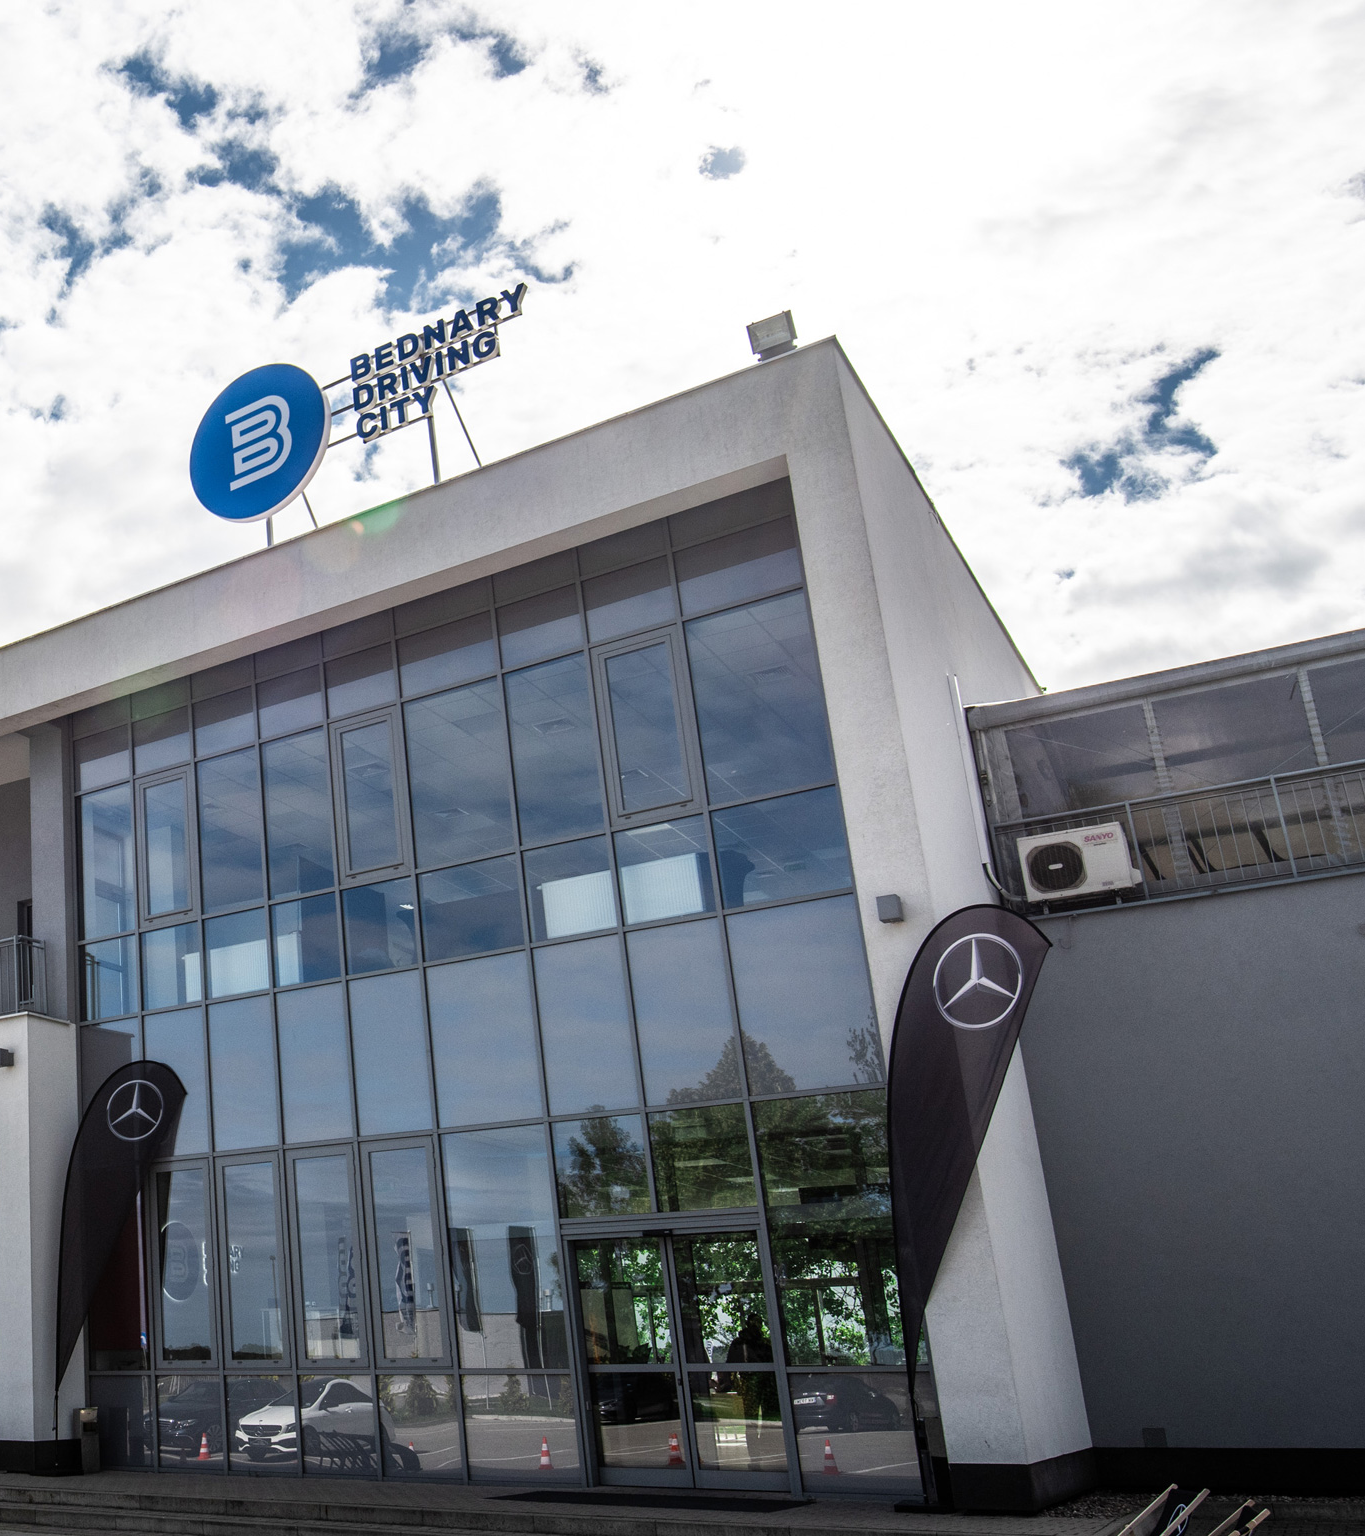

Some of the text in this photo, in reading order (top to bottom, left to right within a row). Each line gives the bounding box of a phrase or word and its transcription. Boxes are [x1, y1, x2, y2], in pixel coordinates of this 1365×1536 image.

[350, 282, 527, 383] BEDNARY
[352, 331, 500, 413] DRIVING
[225, 395, 292, 492] B
[356, 385, 437, 440] CITY
[1084, 832, 1114, 842] SANYO
